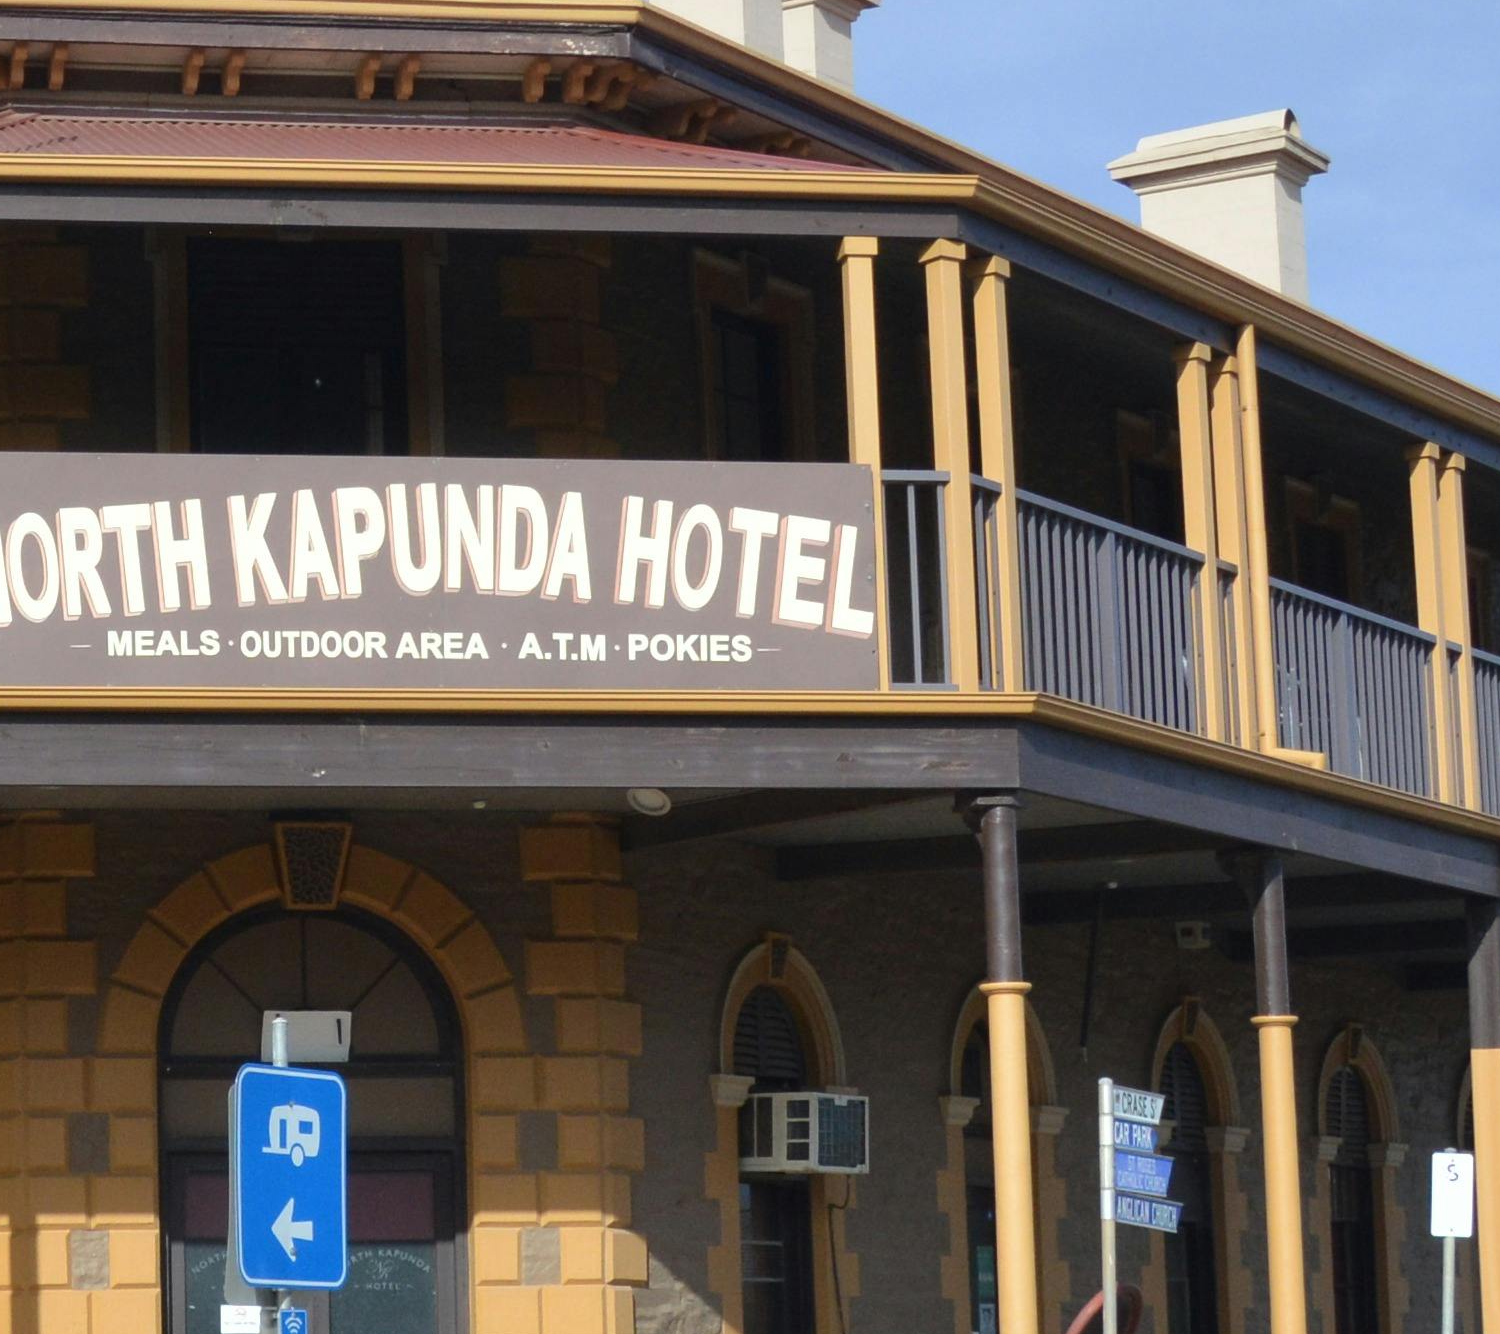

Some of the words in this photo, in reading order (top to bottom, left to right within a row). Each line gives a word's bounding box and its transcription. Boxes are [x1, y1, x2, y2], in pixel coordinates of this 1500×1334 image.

[226, 482, 592, 609] KAPUNDA
[613, 495, 875, 640] HOTEL
[106, 629, 221, 657] MEALS
[239, 630, 387, 659] OUTDOOR
[395, 631, 489, 660] AREA
[518, 632, 606, 662] A.T.M
[627, 633, 753, 663] POKIES
[1122, 1092, 1148, 1118] CRASE
[1114, 1121, 1130, 1145] CAR
[1132, 1124, 1153, 1149] PARK
[1144, 1174, 1168, 1194] CHURCH
[1116, 1195, 1150, 1224] ANGLICAN
[1151, 1202, 1177, 1230] CHURCH
[378, 1248, 431, 1274] KAPUNDA
[366, 1281, 402, 1291] HOTEL
